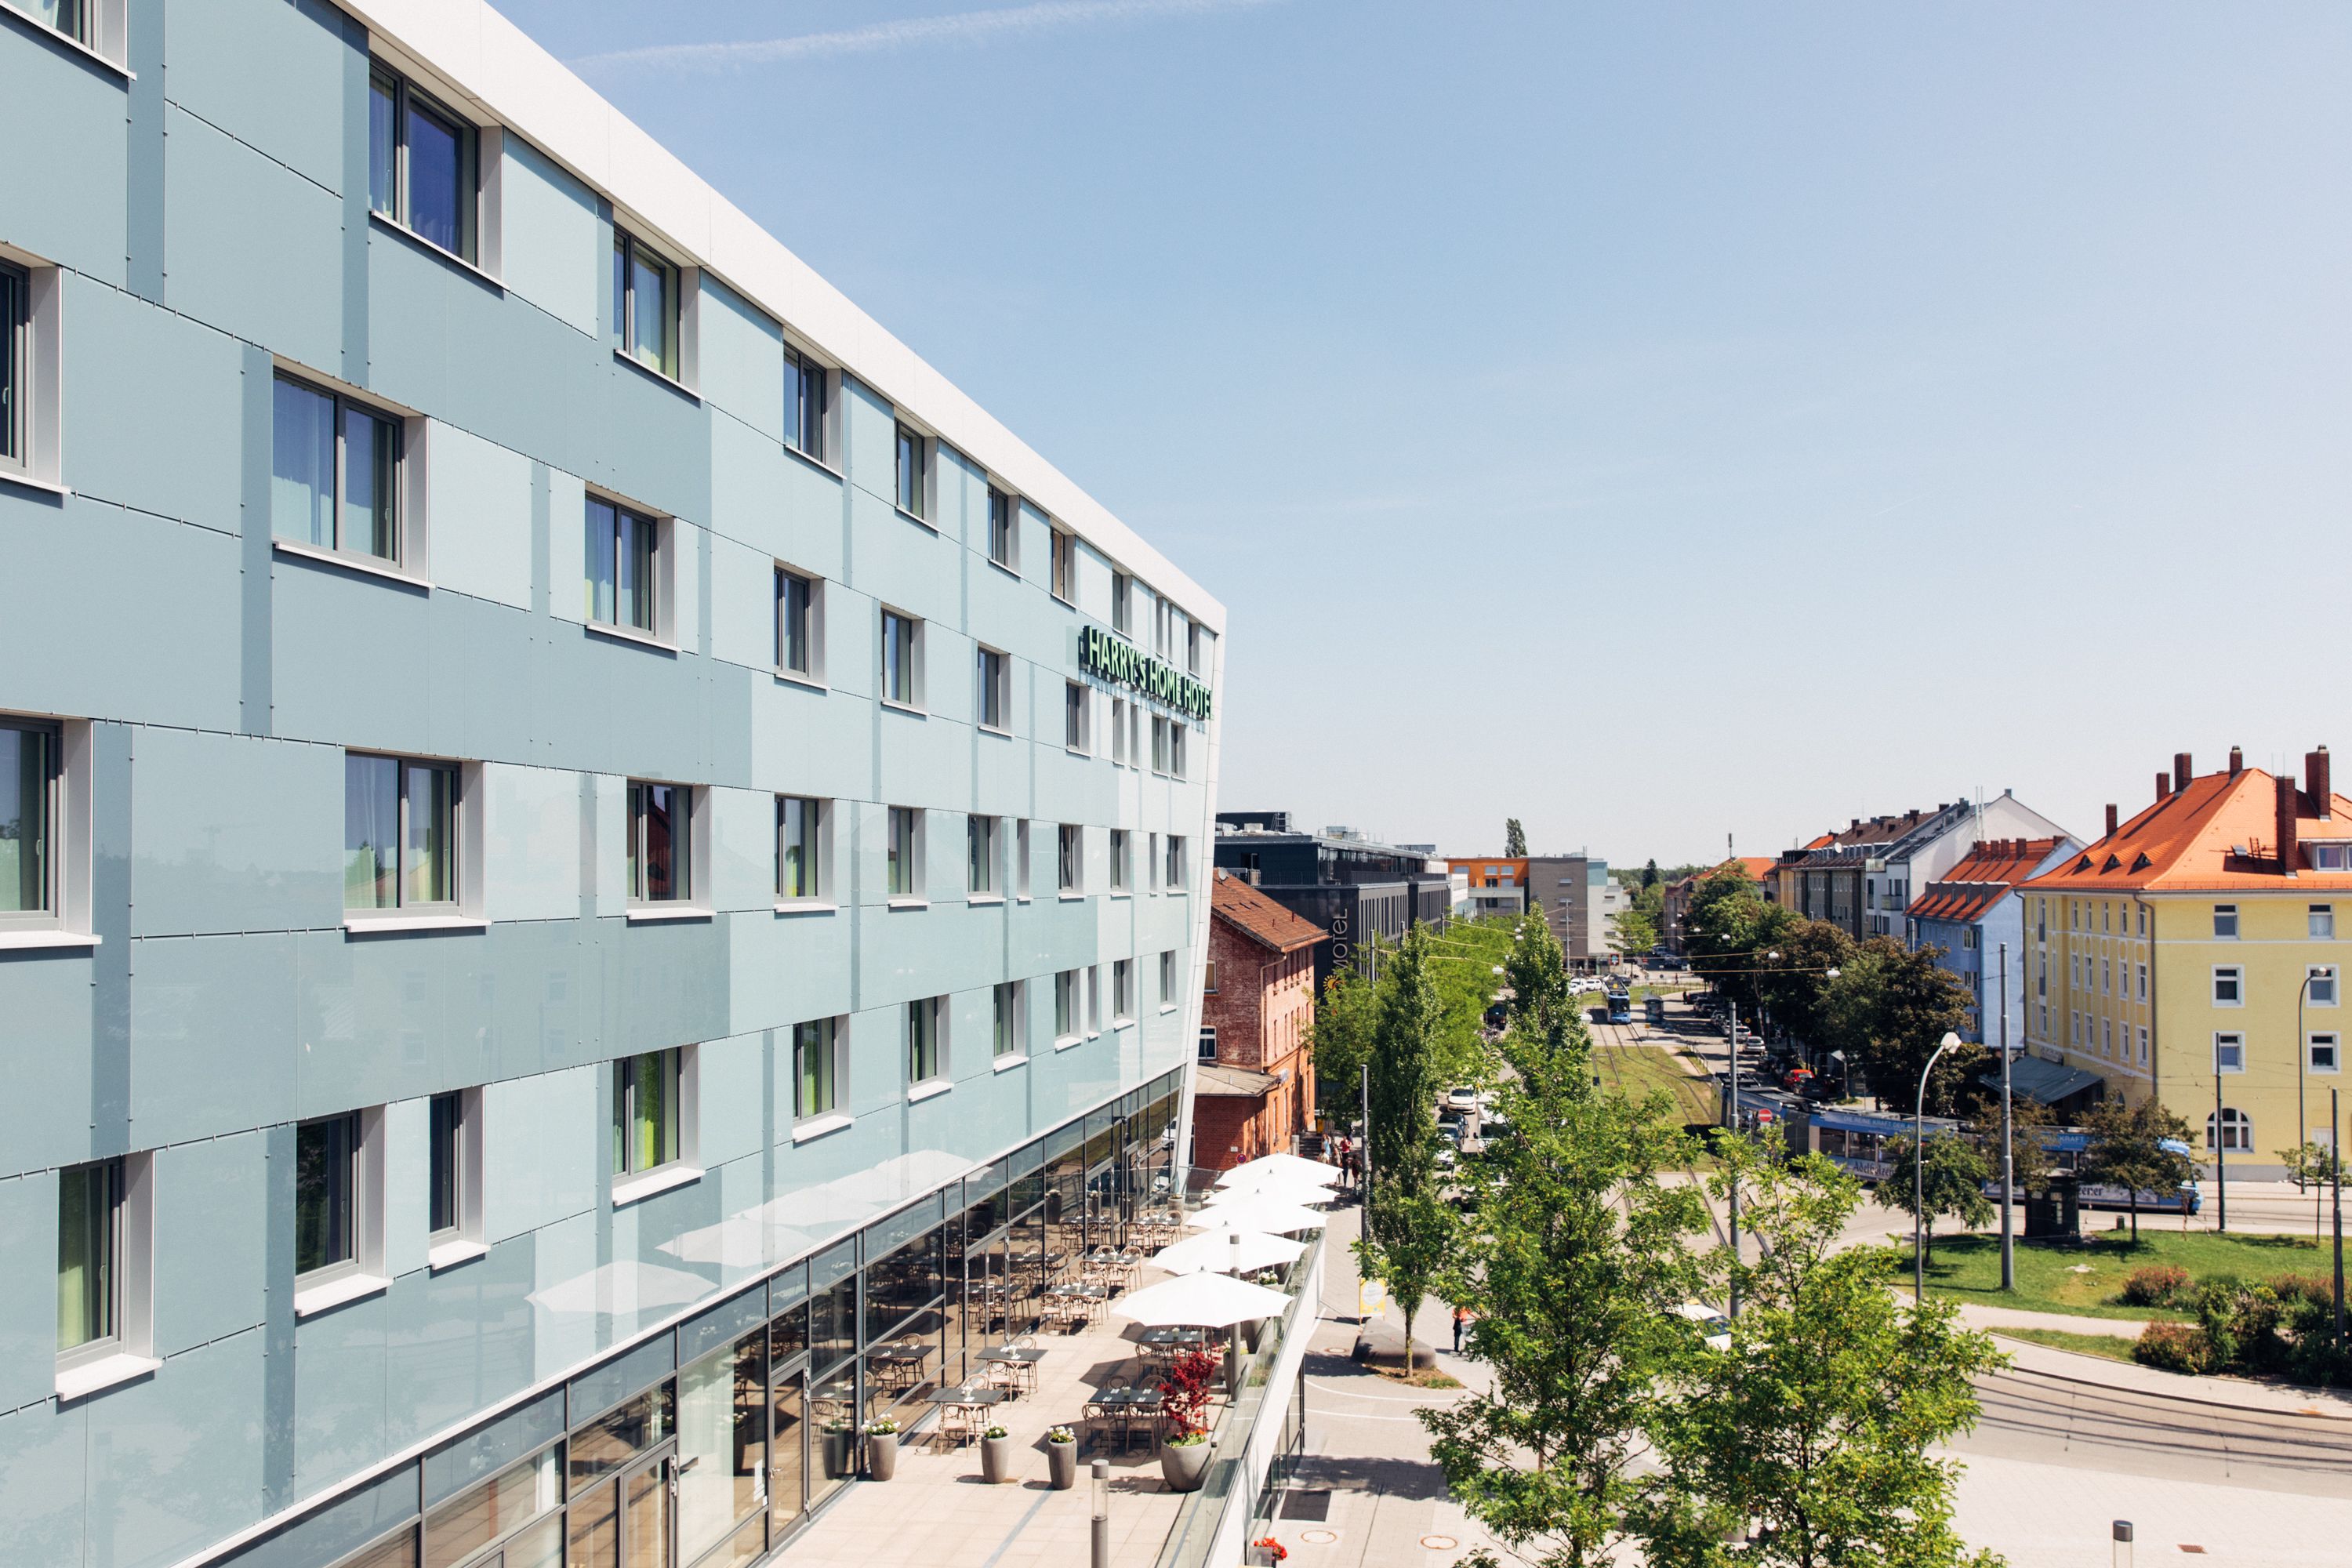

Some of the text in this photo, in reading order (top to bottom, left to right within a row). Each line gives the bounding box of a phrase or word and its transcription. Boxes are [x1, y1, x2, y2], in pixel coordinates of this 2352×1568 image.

[1084, 626, 1214, 720] HARRY'S HOME HOTEL
